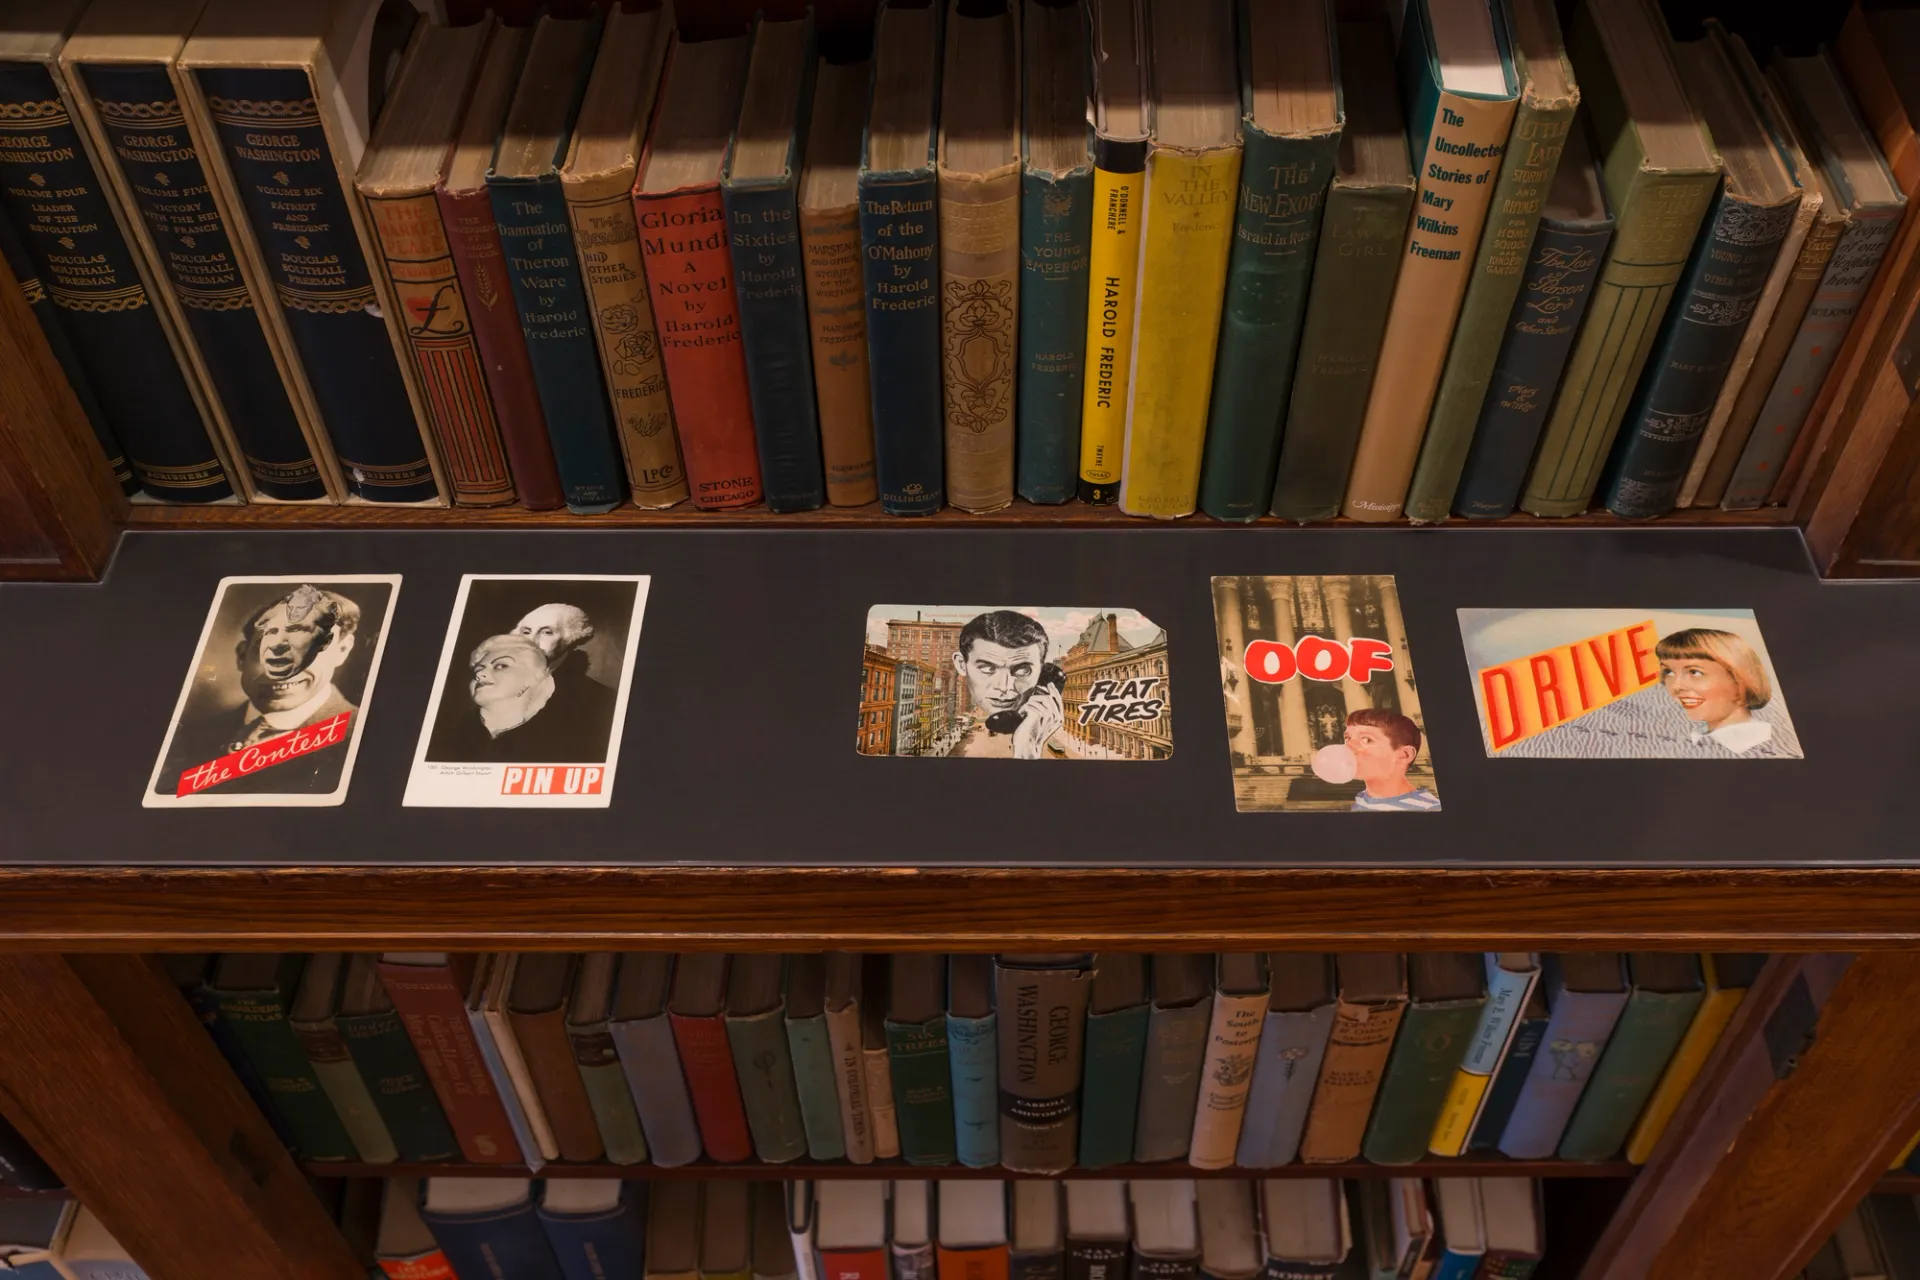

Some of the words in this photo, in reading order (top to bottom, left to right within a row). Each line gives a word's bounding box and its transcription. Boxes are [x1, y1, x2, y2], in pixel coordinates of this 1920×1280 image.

[1441, 107, 1465, 128] The
[123, 134, 178, 148] GEORGE
[246, 133, 300, 147] GEORGE
[235, 146, 321, 162] WASHINGTON
[1188, 165, 1212, 179] IN
[1428, 163, 1472, 185] Stories
[1475, 169, 1491, 184] of
[8, 187, 53, 198] VOLUME
[55, 187, 88, 198] FOUR
[182, 184, 211, 198] FIVE
[257, 185, 302, 197] VOLUME
[304, 187, 323, 197] SIX
[1180, 179, 1220, 192] THE
[1516, 189, 1537, 197] AND
[1163, 188, 1233, 206] VALLEY
[1240, 183, 1272, 215] NEW
[1421, 189, 1454, 211] Mary
[31, 203, 76, 212] LEADER
[271, 201, 317, 212] PATRIOT
[512, 201, 544, 216] The
[865, 200, 890, 216] The
[889, 199, 932, 215] Return
[1107, 188, 1119, 231] FRANCHERE
[1118, 185, 1130, 226] O'DONNELL
[1502, 199, 1540, 215] RHYMES
[37, 215, 52, 223] OF
[54, 214, 79, 223] THE
[170, 212, 195, 223] THE
[285, 212, 309, 222] AND
[640, 206, 724, 230] Gloria
[733, 210, 752, 224] In
[762, 206, 792, 221] the
[174, 223, 219, 235] FRANCE
[499, 216, 568, 237] Damnation
[877, 223, 893, 237] of
[899, 221, 924, 236] the
[1417, 214, 1459, 237] Wilkins
[733, 232, 797, 247] Sixties
[1043, 233, 1071, 243] THE
[1238, 223, 1272, 246] Israel
[1497, 228, 1530, 239] HOME
[528, 238, 545, 251] of
[645, 229, 729, 256] Mundi
[1839, 240, 1864, 253] of
[1858, 243, 1887, 252] our
[171, 252, 227, 264] DOUGLAS
[280, 253, 339, 264] DOUGLAS
[758, 252, 775, 266] by
[868, 243, 934, 264] O'Mahony
[1033, 245, 1080, 258] YOUNG
[1409, 241, 1462, 262] Freeman
[1711, 248, 1741, 264] YOUNG
[48, 254, 106, 265] DOUGLAS
[511, 256, 570, 272] Theron
[1026, 256, 1088, 274] EMPEROR
[1534, 247, 1574, 269] The
[1565, 249, 1597, 273] Love
[50, 264, 116, 275] SOUTHALL
[172, 263, 234, 274] SOUTHALL
[283, 263, 346, 275] SOUTHALL
[588, 263, 630, 274] OTHER
[684, 262, 697, 274] A
[742, 267, 796, 282] Harold
[894, 263, 912, 279] by
[1486, 265, 1520, 276] GARTEN
[57, 275, 117, 286] FREEMAN
[178, 273, 235, 285] FREEMAN
[287, 274, 347, 286] FREEMAN
[520, 276, 567, 290] Ware
[591, 271, 637, 285] STORIES
[1528, 275, 1585, 296] Parson
[1703, 273, 1735, 287] OTHER
[1824, 271, 1868, 287] hood
[659, 277, 727, 296] Novel
[737, 284, 802, 299] Frederic
[877, 278, 929, 294] Harold
[538, 295, 555, 309] by
[684, 301, 705, 314] by
[872, 294, 936, 312] Frederic
[1101, 276, 1121, 339] HAROLD
[1526, 295, 1574, 314] Lord
[525, 310, 578, 324] Harold
[1811, 306, 1855, 317] WILKINS
[665, 315, 734, 333] Harold
[1537, 316, 1560, 325] and
[522, 325, 586, 340] Frederic
[663, 331, 741, 348] Frederic
[1035, 351, 1075, 362] HAROLD
[1097, 347, 1117, 410] FREDERIC
[615, 379, 665, 399] FREDERIC
[699, 477, 754, 492] STONE
[700, 490, 756, 503] CHICAGO
[1092, 488, 1102, 500] 3
[1244, 635, 1395, 684] OOF
[1089, 678, 1160, 703] FLAT
[1482, 624, 1661, 750] DRIVE
[1078, 699, 1164, 726] TIRES
[183, 760, 232, 790] the
[238, 714, 348, 773] Contest
[503, 768, 555, 795] PIN
[563, 768, 601, 795] UP
[242, 1012, 284, 1021] ATLAS
[1235, 1010, 1257, 1020] The
[1225, 1018, 1261, 1029] South
[1016, 984, 1039, 1086] WASHINGTON
[1047, 1004, 1073, 1067] GEORGE
[1235, 1030, 1248, 1039] to
[893, 1037, 948, 1052] TREES
[852, 1110, 867, 1137] TIMES
